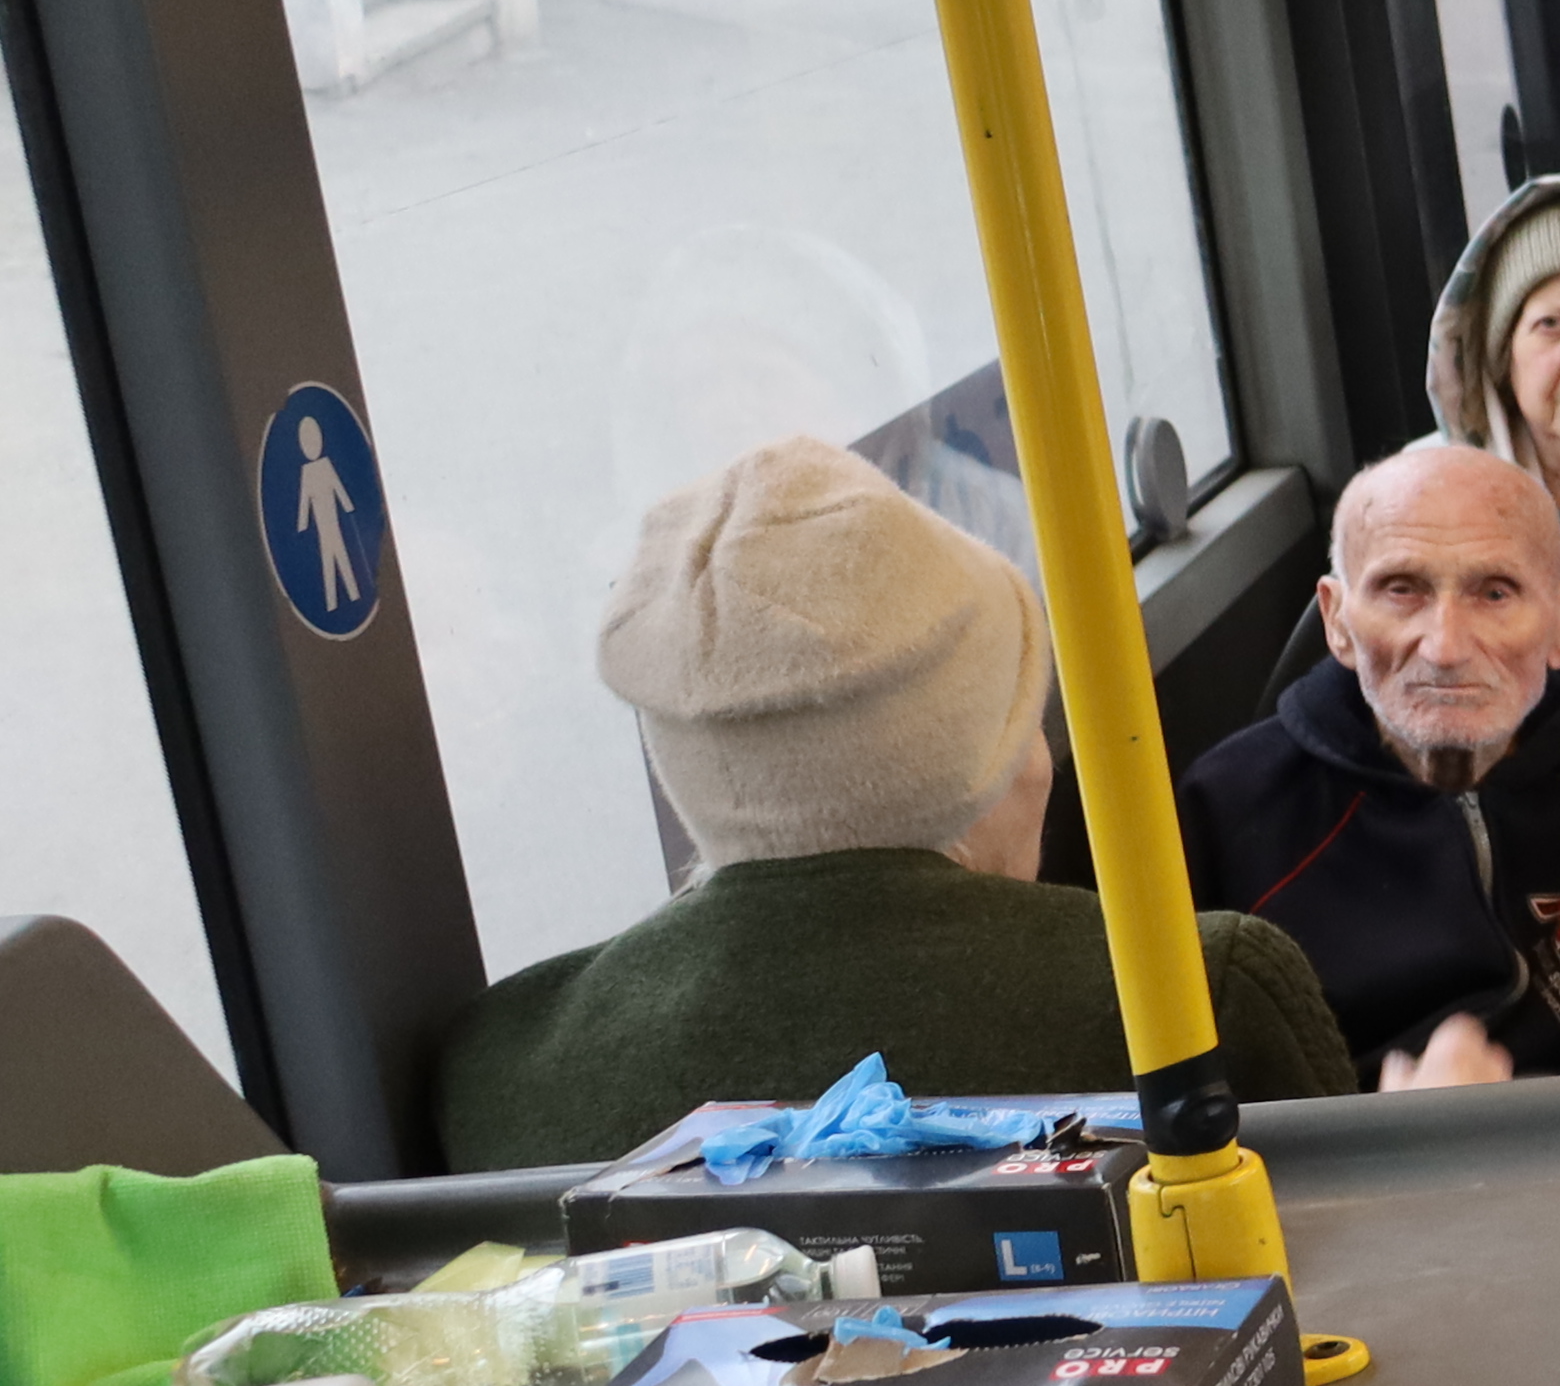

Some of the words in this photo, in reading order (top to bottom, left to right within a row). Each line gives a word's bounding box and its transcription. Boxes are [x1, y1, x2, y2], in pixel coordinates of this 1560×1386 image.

[1001, 1239, 1028, 1275] L
[1064, 1346, 1181, 1359] service
[1054, 1358, 1165, 1379] PRO
